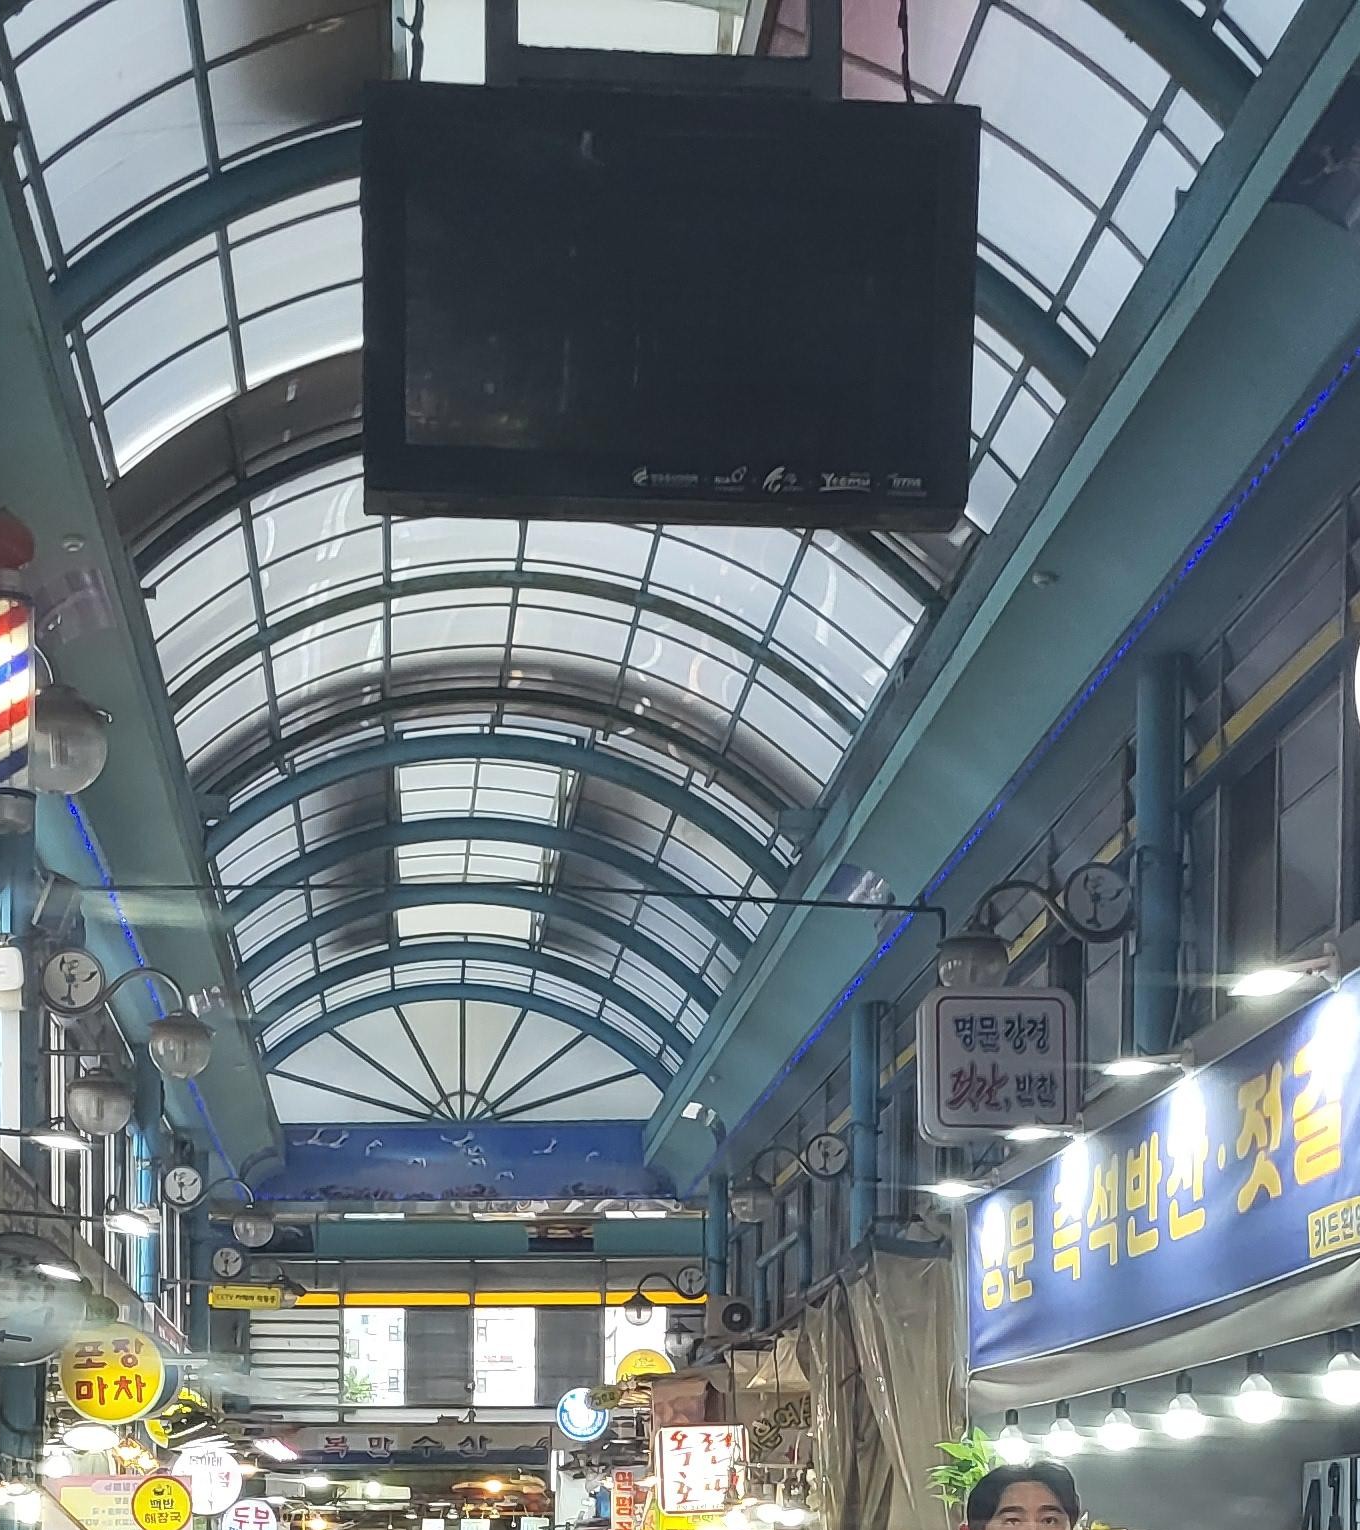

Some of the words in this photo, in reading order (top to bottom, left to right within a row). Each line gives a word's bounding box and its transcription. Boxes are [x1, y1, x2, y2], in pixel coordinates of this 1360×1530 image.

[73, 1337, 145, 1370] 포장
[75, 1374, 147, 1406] 마차
[232, 1506, 271, 1530] 두부
